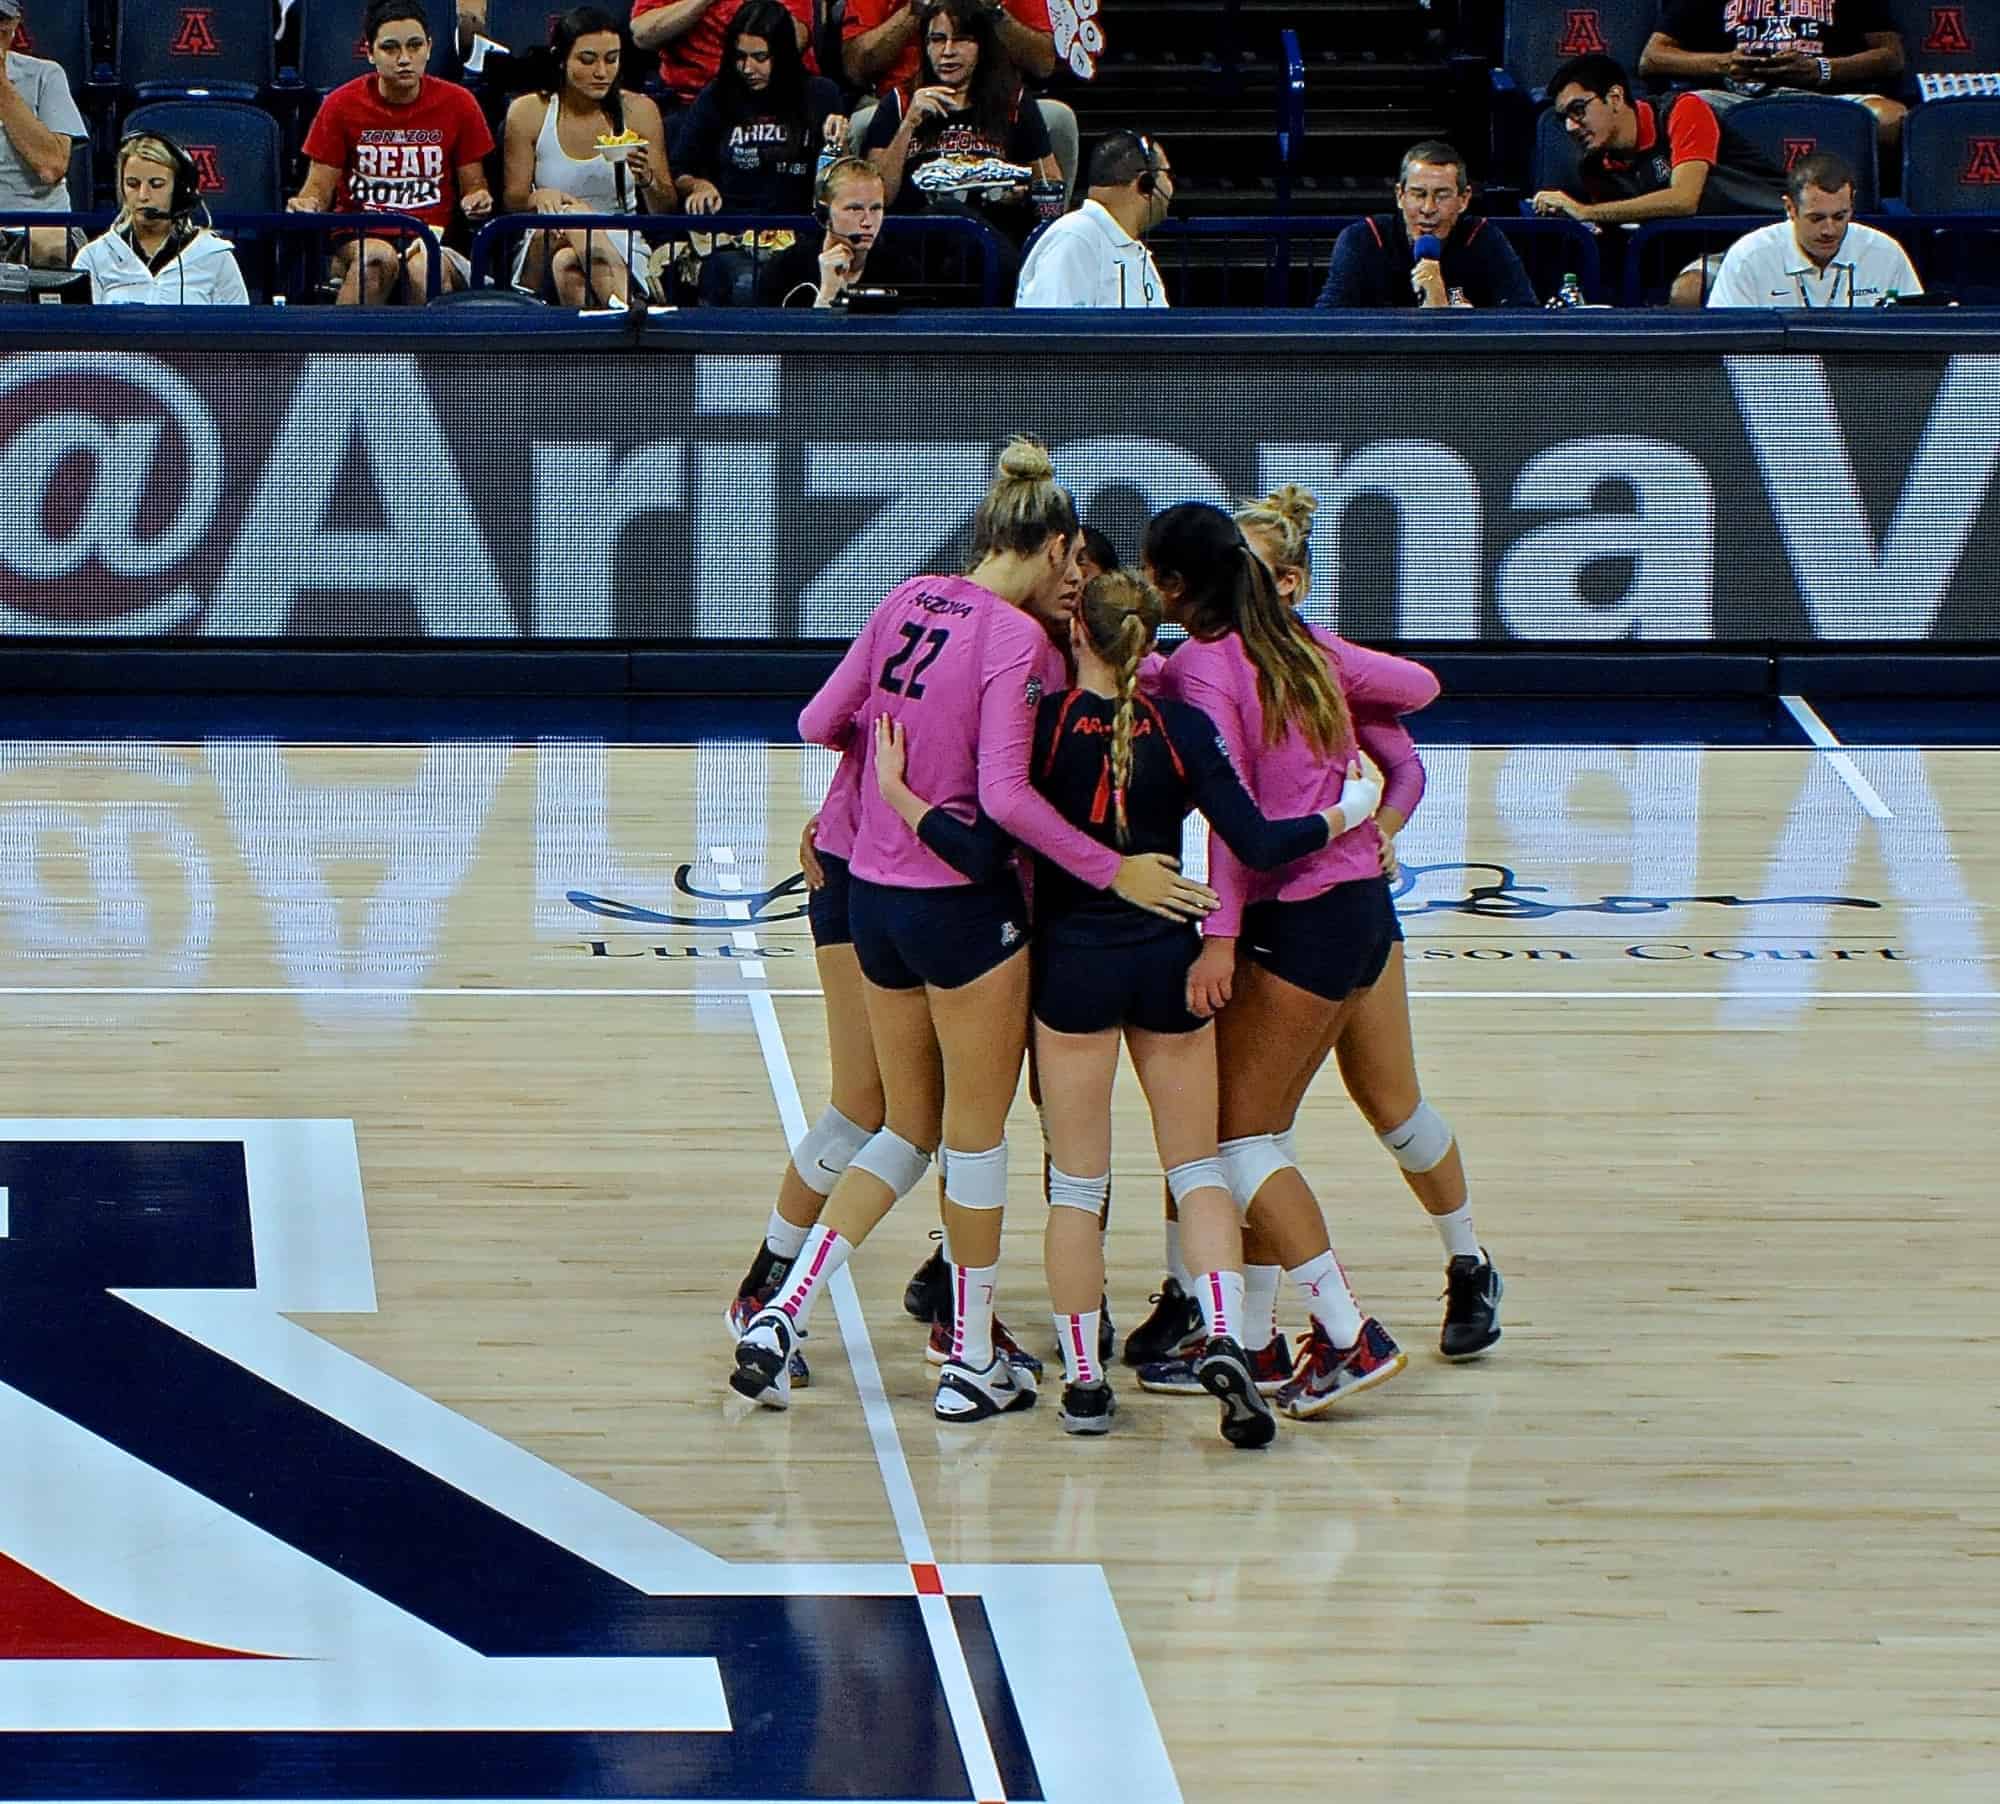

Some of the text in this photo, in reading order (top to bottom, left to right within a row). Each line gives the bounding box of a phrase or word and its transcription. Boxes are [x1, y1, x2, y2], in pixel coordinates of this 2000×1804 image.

[171, 9, 220, 55] A
[1558, 9, 1608, 56] A
[1921, 6, 1975, 53] A
[356, 145, 443, 177] BEAR
[878, 621, 950, 700] 22
[578, 941, 796, 960] Lute
[1624, 943, 1908, 961] Court
